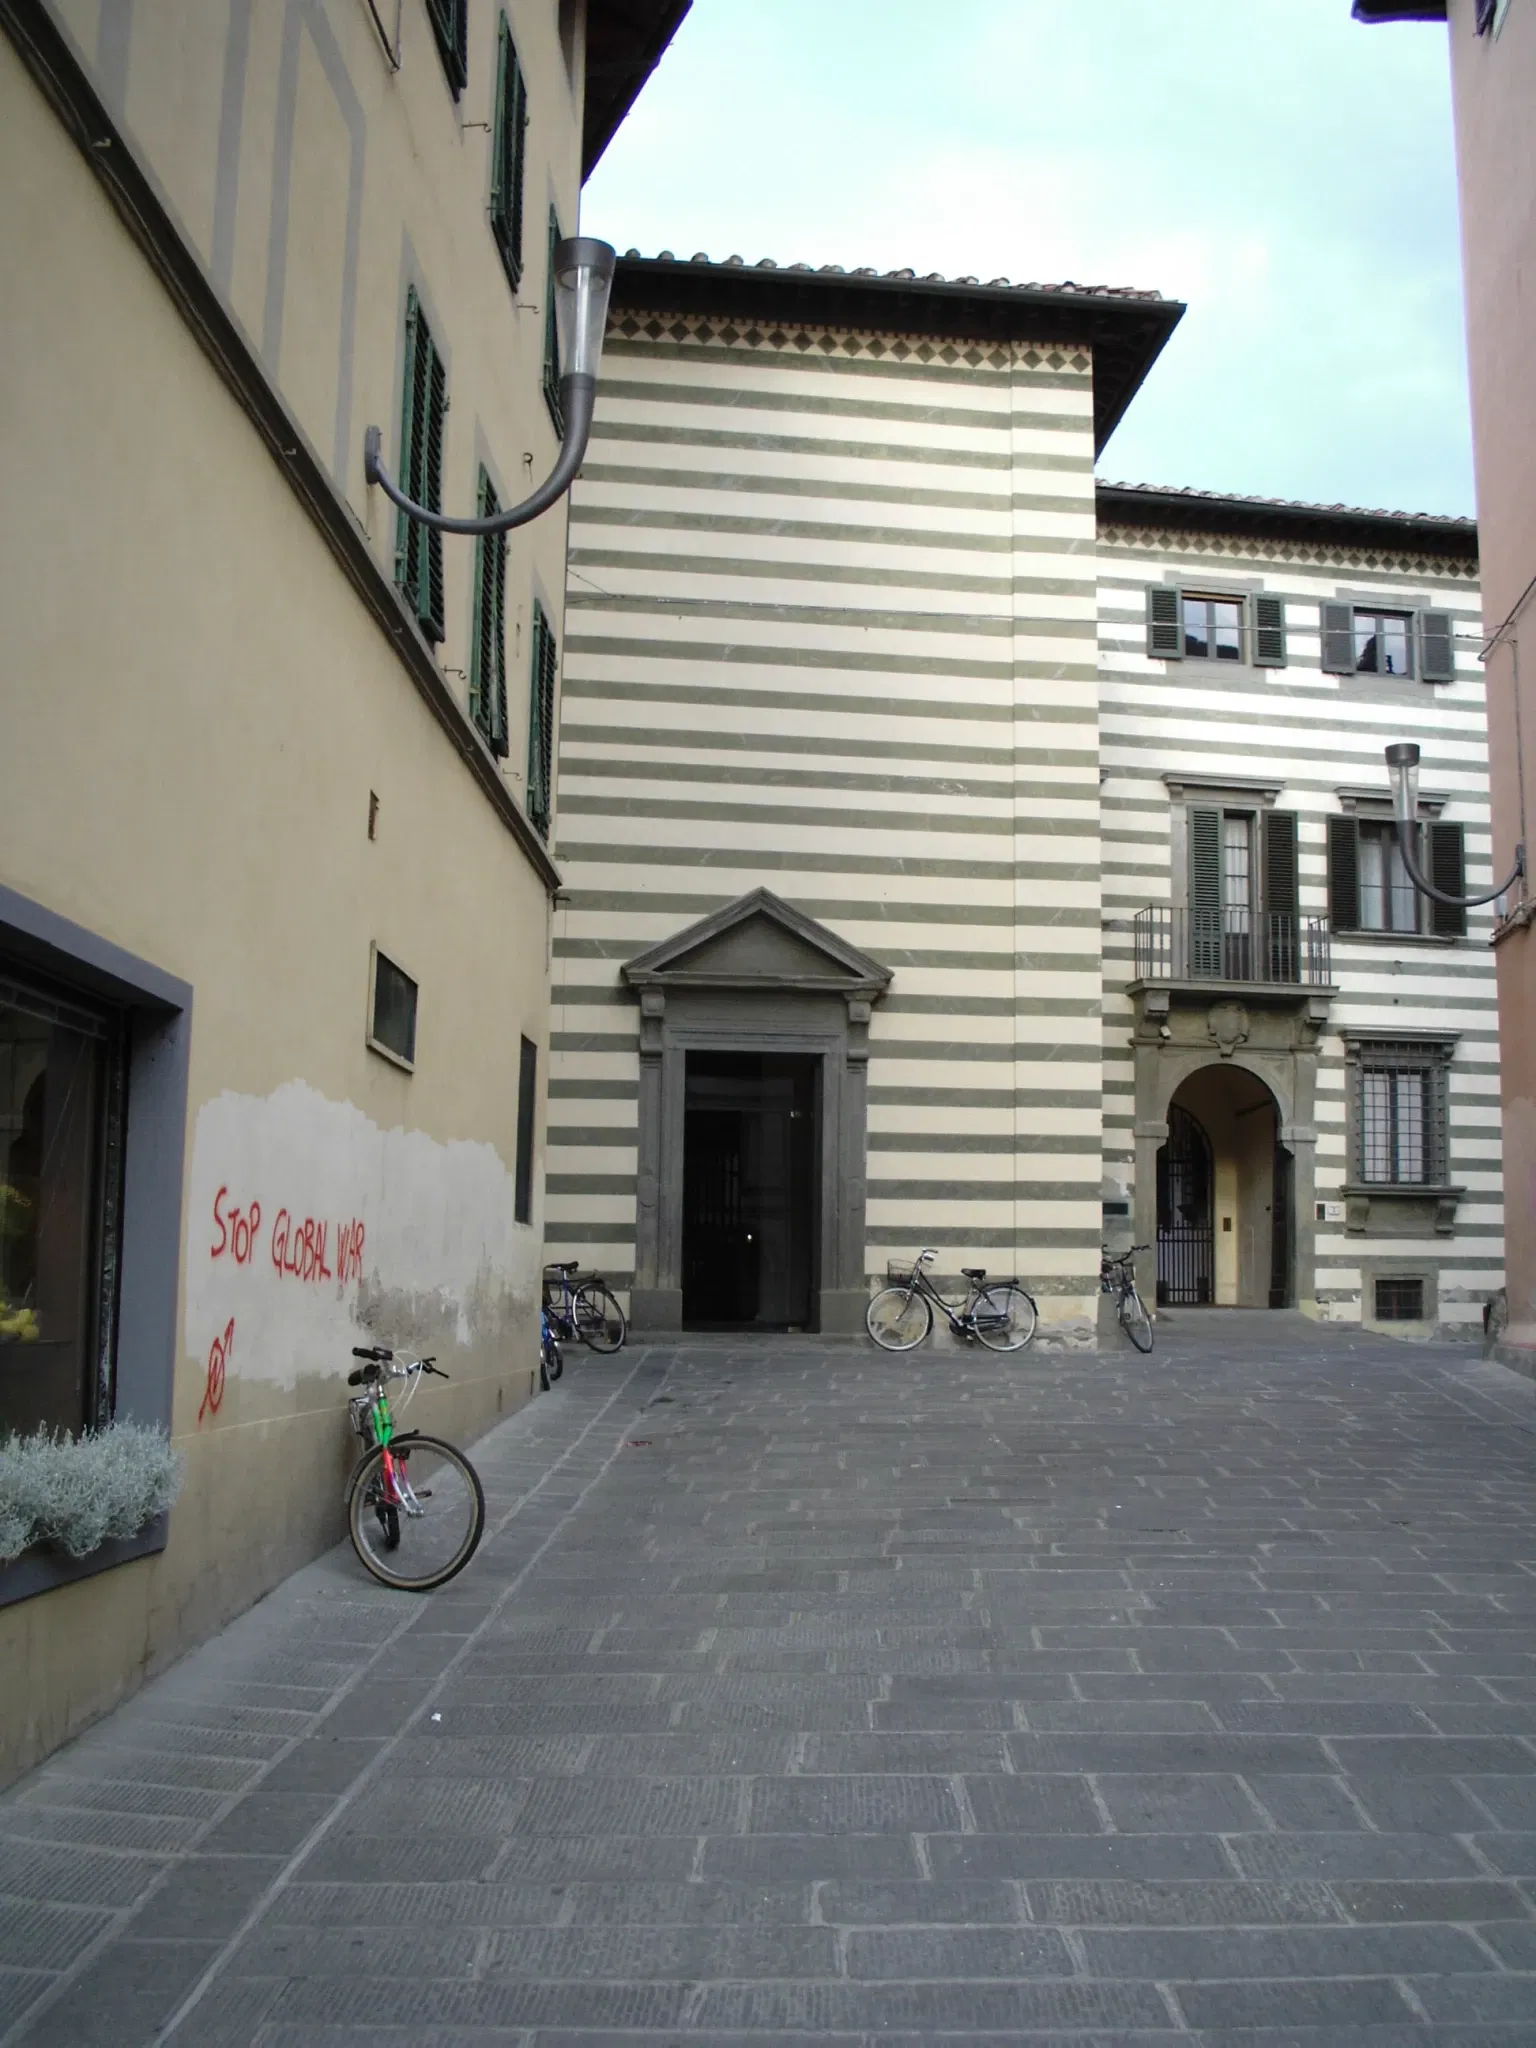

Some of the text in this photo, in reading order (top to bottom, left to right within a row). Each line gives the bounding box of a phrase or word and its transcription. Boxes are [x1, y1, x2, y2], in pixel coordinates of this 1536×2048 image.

[210, 1185, 365, 1289] STOP GLOBAL WAR
